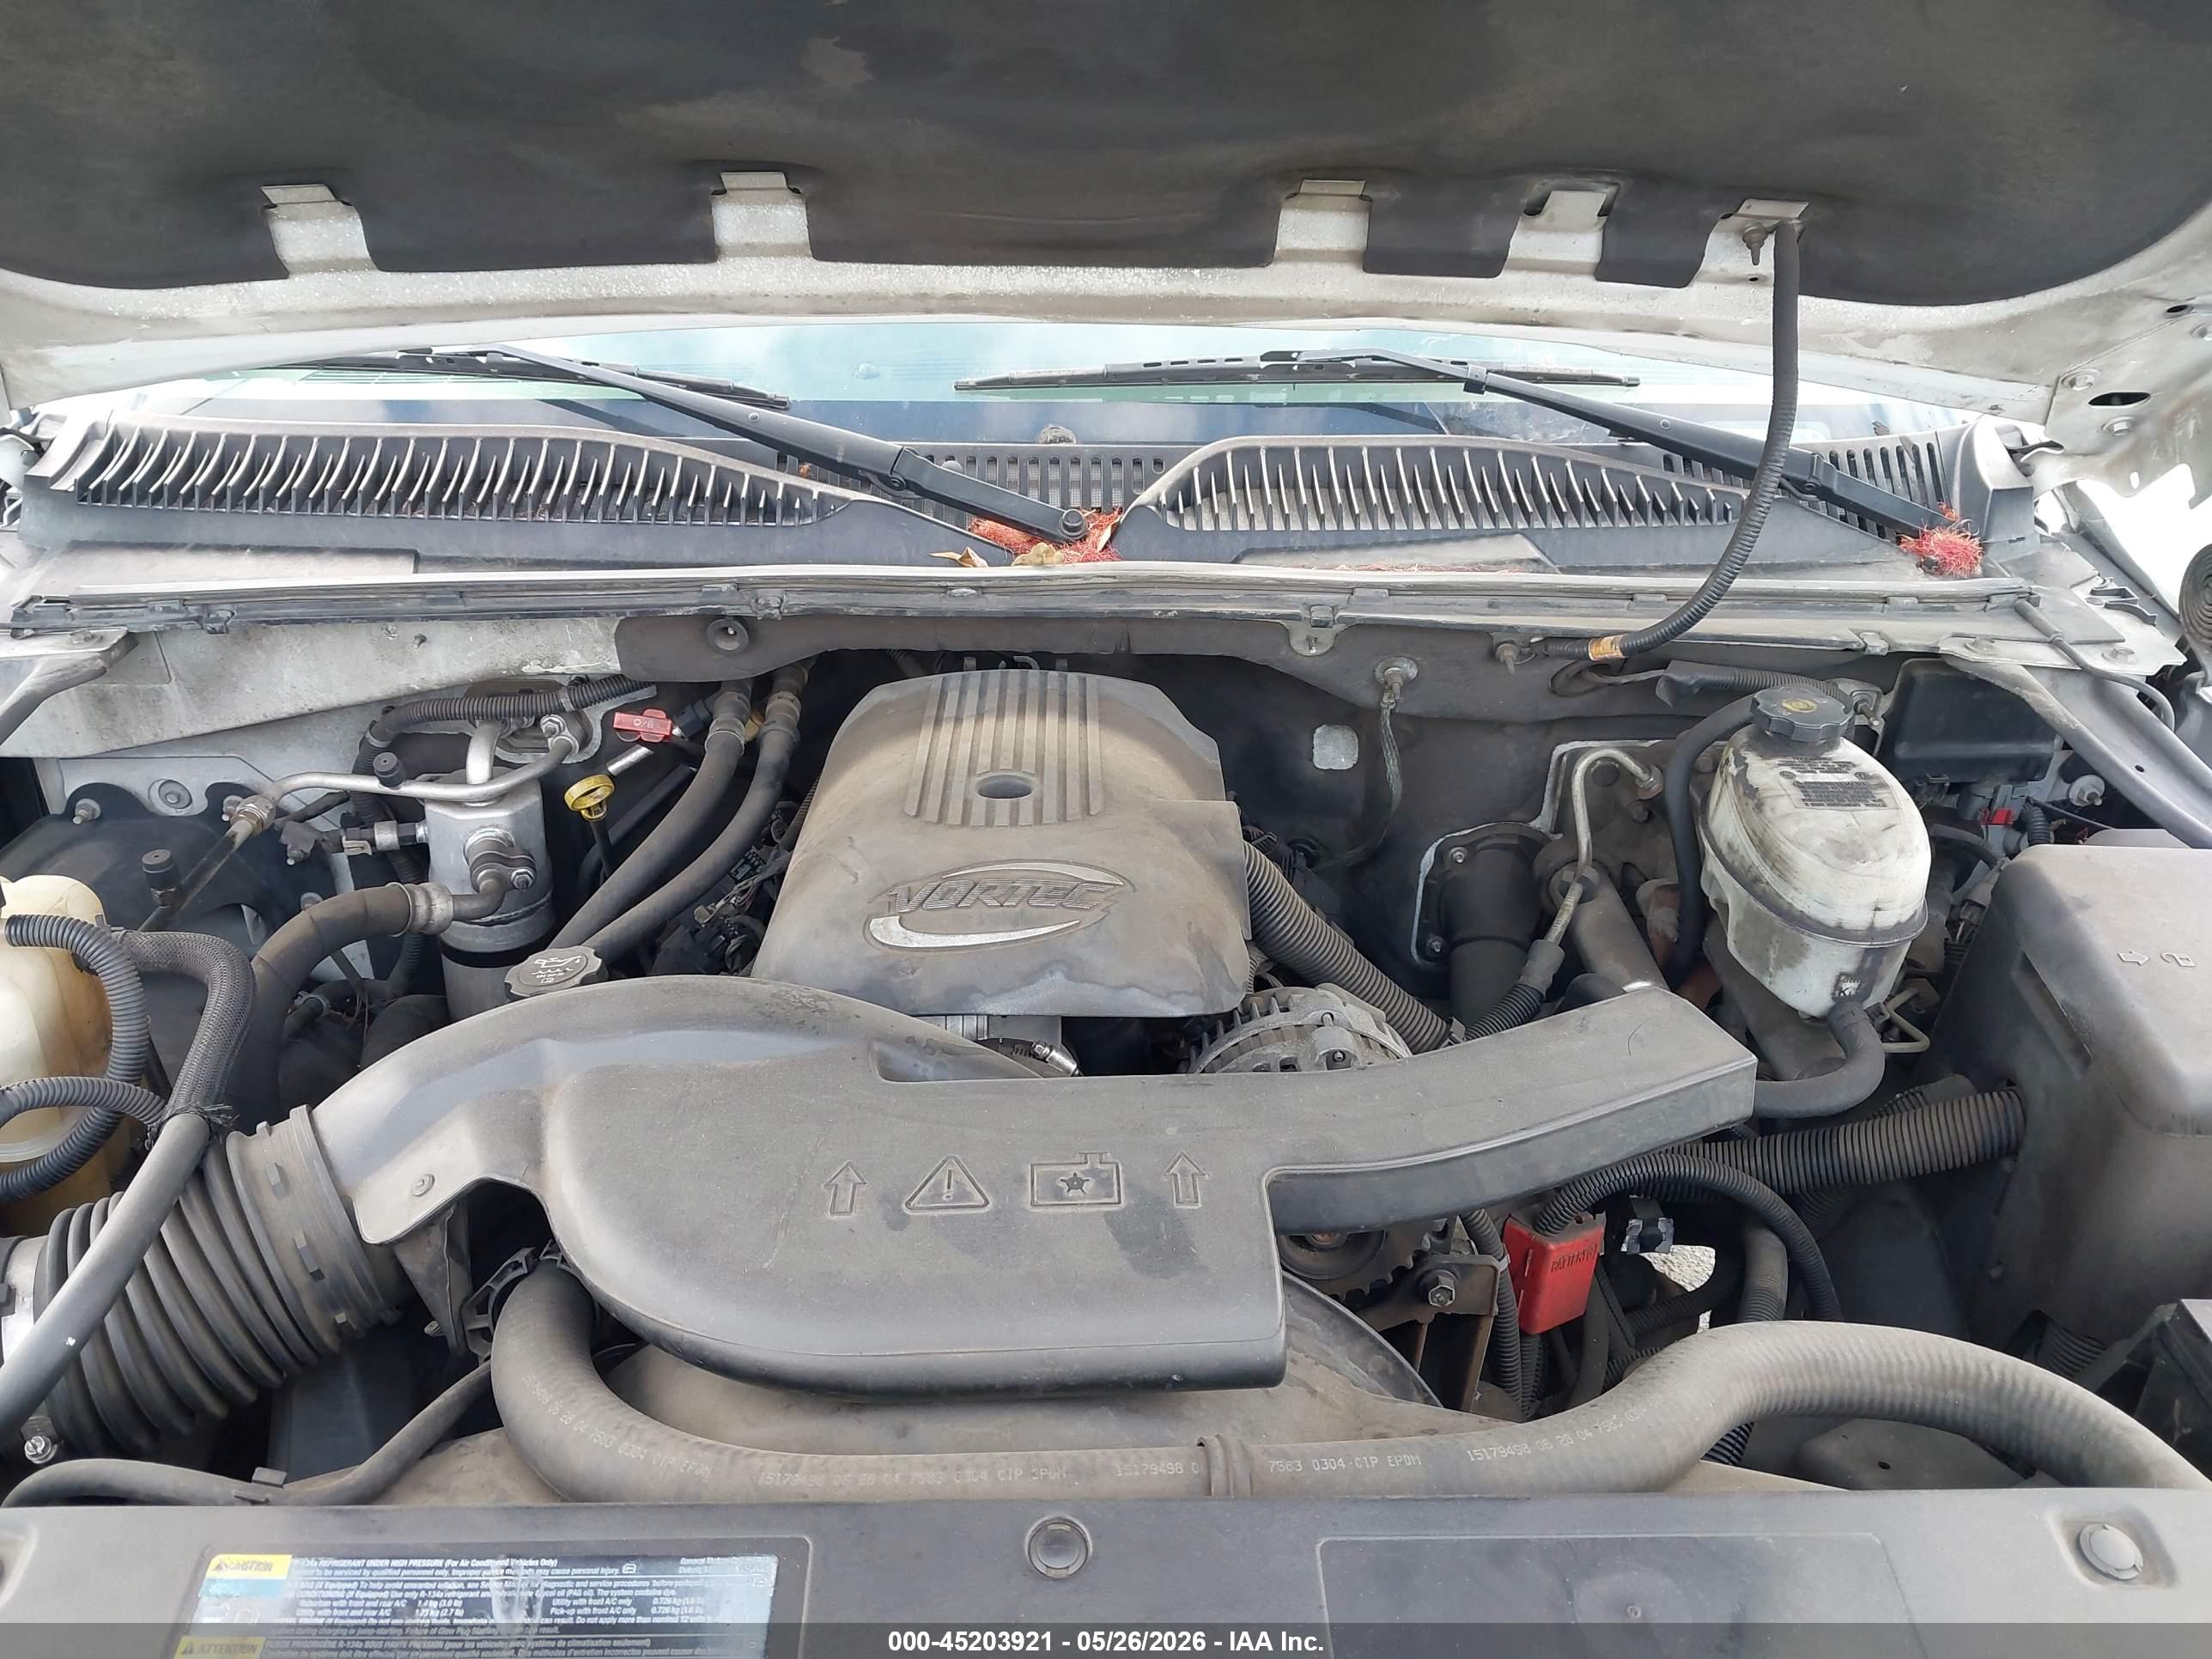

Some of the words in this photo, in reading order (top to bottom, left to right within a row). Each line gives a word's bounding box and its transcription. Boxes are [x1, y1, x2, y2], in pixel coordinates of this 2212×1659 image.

[888, 878, 1115, 914] VORTEC
[1467, 1443, 1532, 1462] 15179498
[1388, 1455, 1422, 1468] EPDM
[1115, 1462, 1184, 1476] 15179498
[319, 1559, 365, 1567] REFRIGERANT
[365, 1559, 390, 1567] UNDER
[391, 1559, 408, 1567] HIGH
[408, 1559, 445, 1567] PRESSURE
[445, 1559, 460, 1568] (For
[459, 1559, 471, 1567] Air
[540, 1559, 558, 1567] Only)
[550, 1607, 576, 1616] Pick-up
[198, 1644, 258, 1654] ATTENTION
